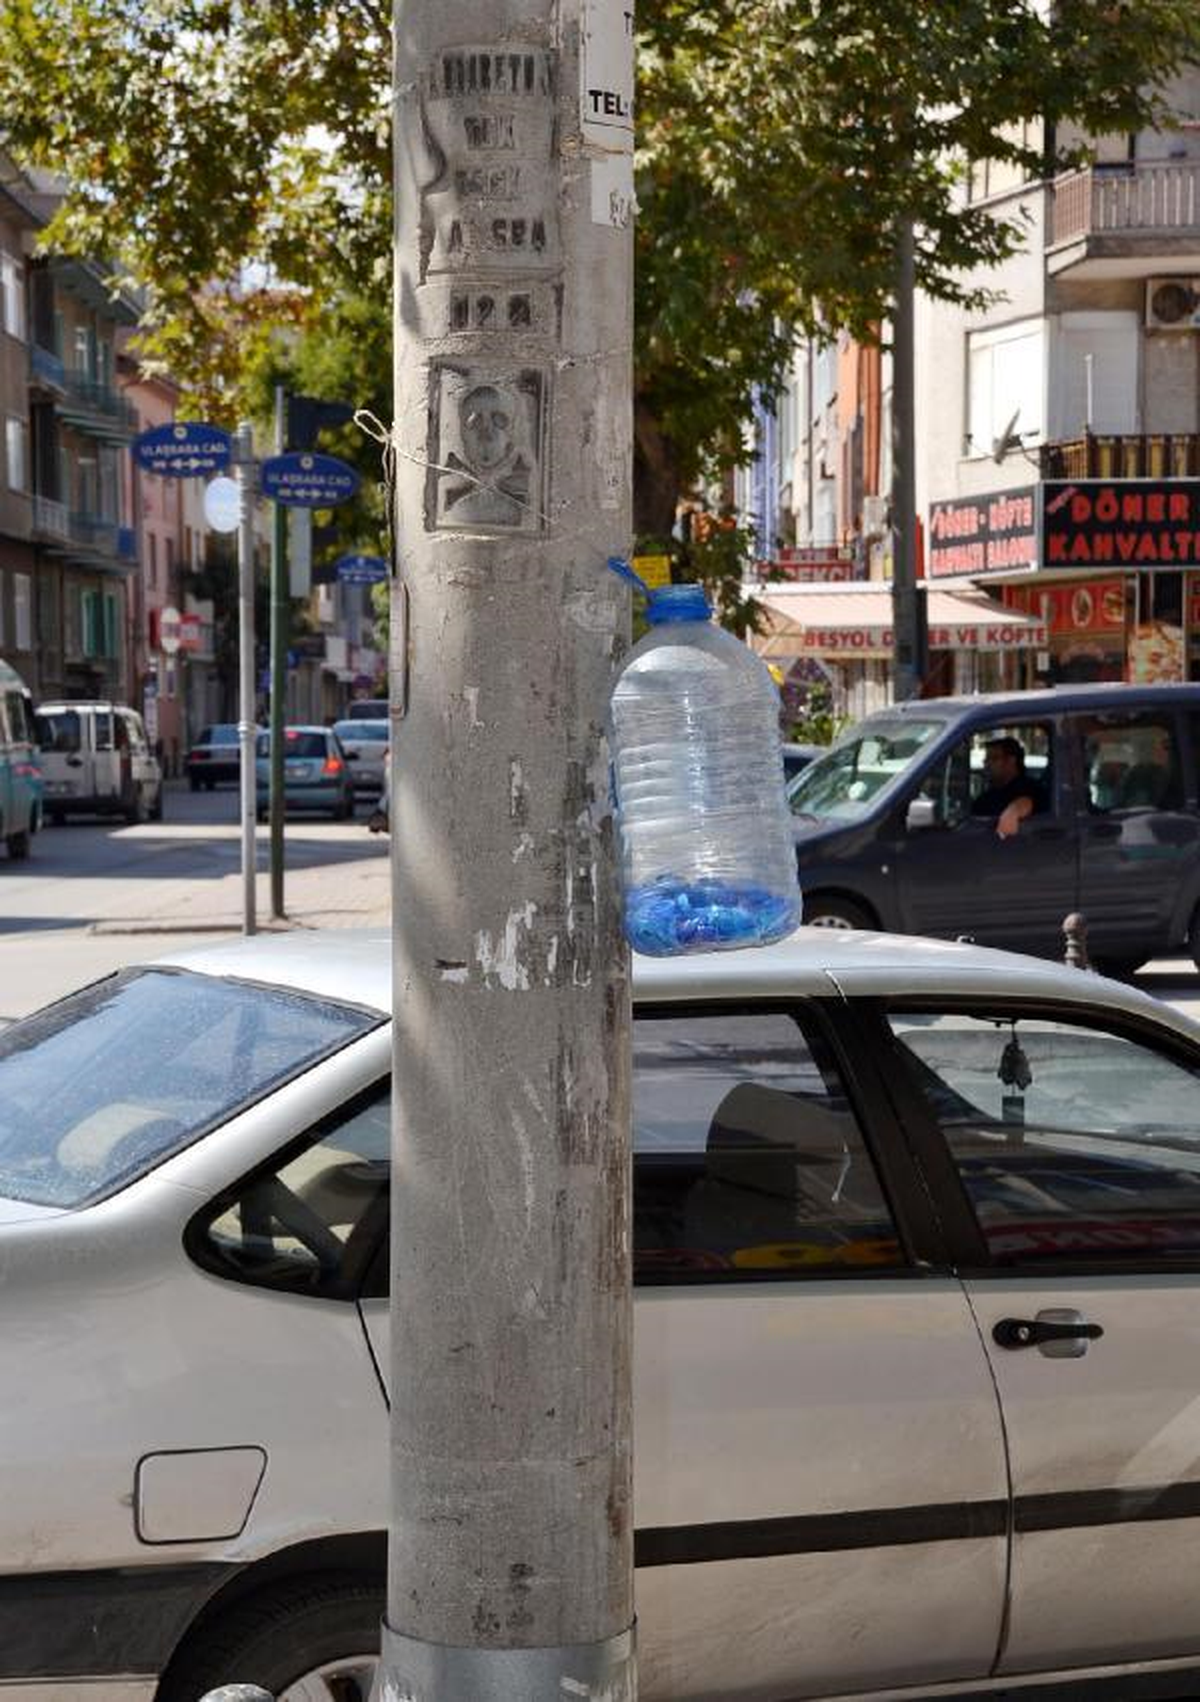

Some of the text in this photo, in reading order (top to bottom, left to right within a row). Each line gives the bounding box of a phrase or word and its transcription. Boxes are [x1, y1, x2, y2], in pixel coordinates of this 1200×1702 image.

[588, 89, 628, 117] TEL:
[1070, 487, 1190, 523] DÖNER
[957, 627, 979, 645] VE
[987, 624, 1046, 645] KÖFTE
